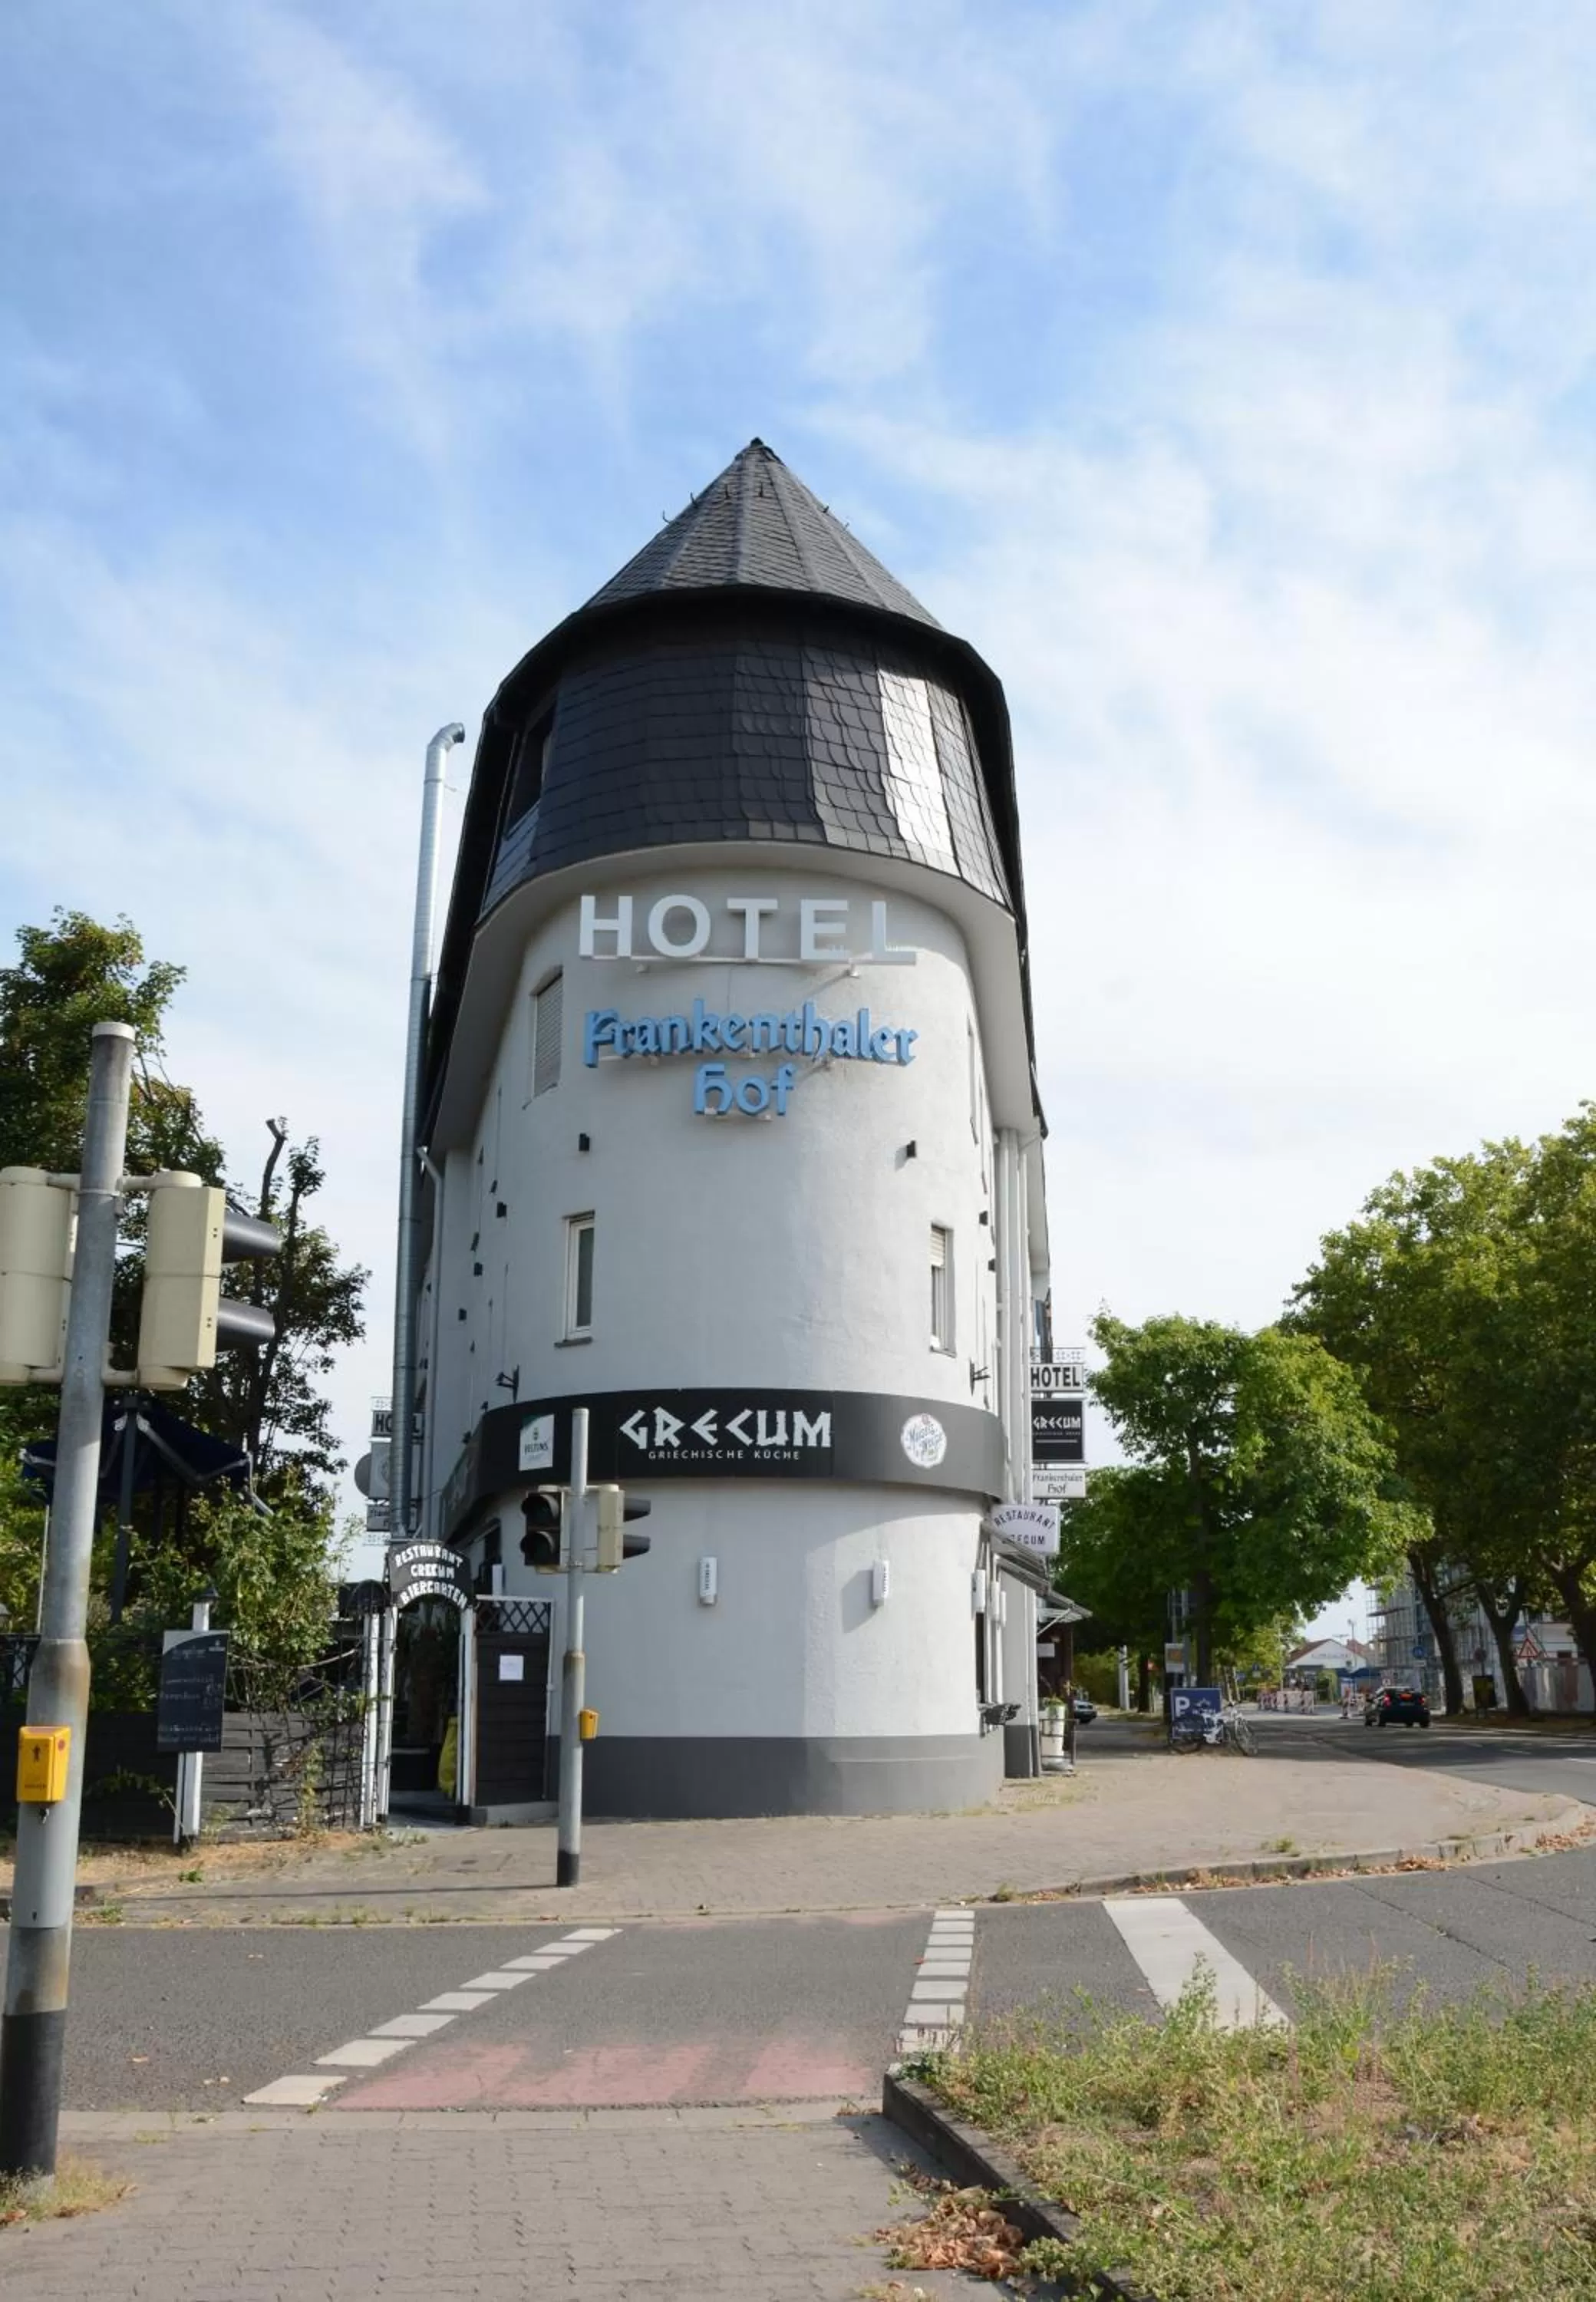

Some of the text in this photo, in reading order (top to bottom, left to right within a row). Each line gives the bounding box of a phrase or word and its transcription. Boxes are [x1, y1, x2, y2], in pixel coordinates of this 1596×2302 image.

[579, 894, 916, 965] HOTEL
[582, 998, 919, 1067] Frankenthaler
[1030, 1367, 1080, 1387] HOTEL
[619, 1406, 831, 1449] GRECUM
[1032, 1416, 1081, 1430] GRECUM
[648, 1449, 800, 1459] GRIECHISCHE KÜCHE
[994, 1509, 1055, 1530] RESTAURANT
[394, 1545, 463, 1568] RESTAURANT
[1175, 1696, 1190, 1718] P
